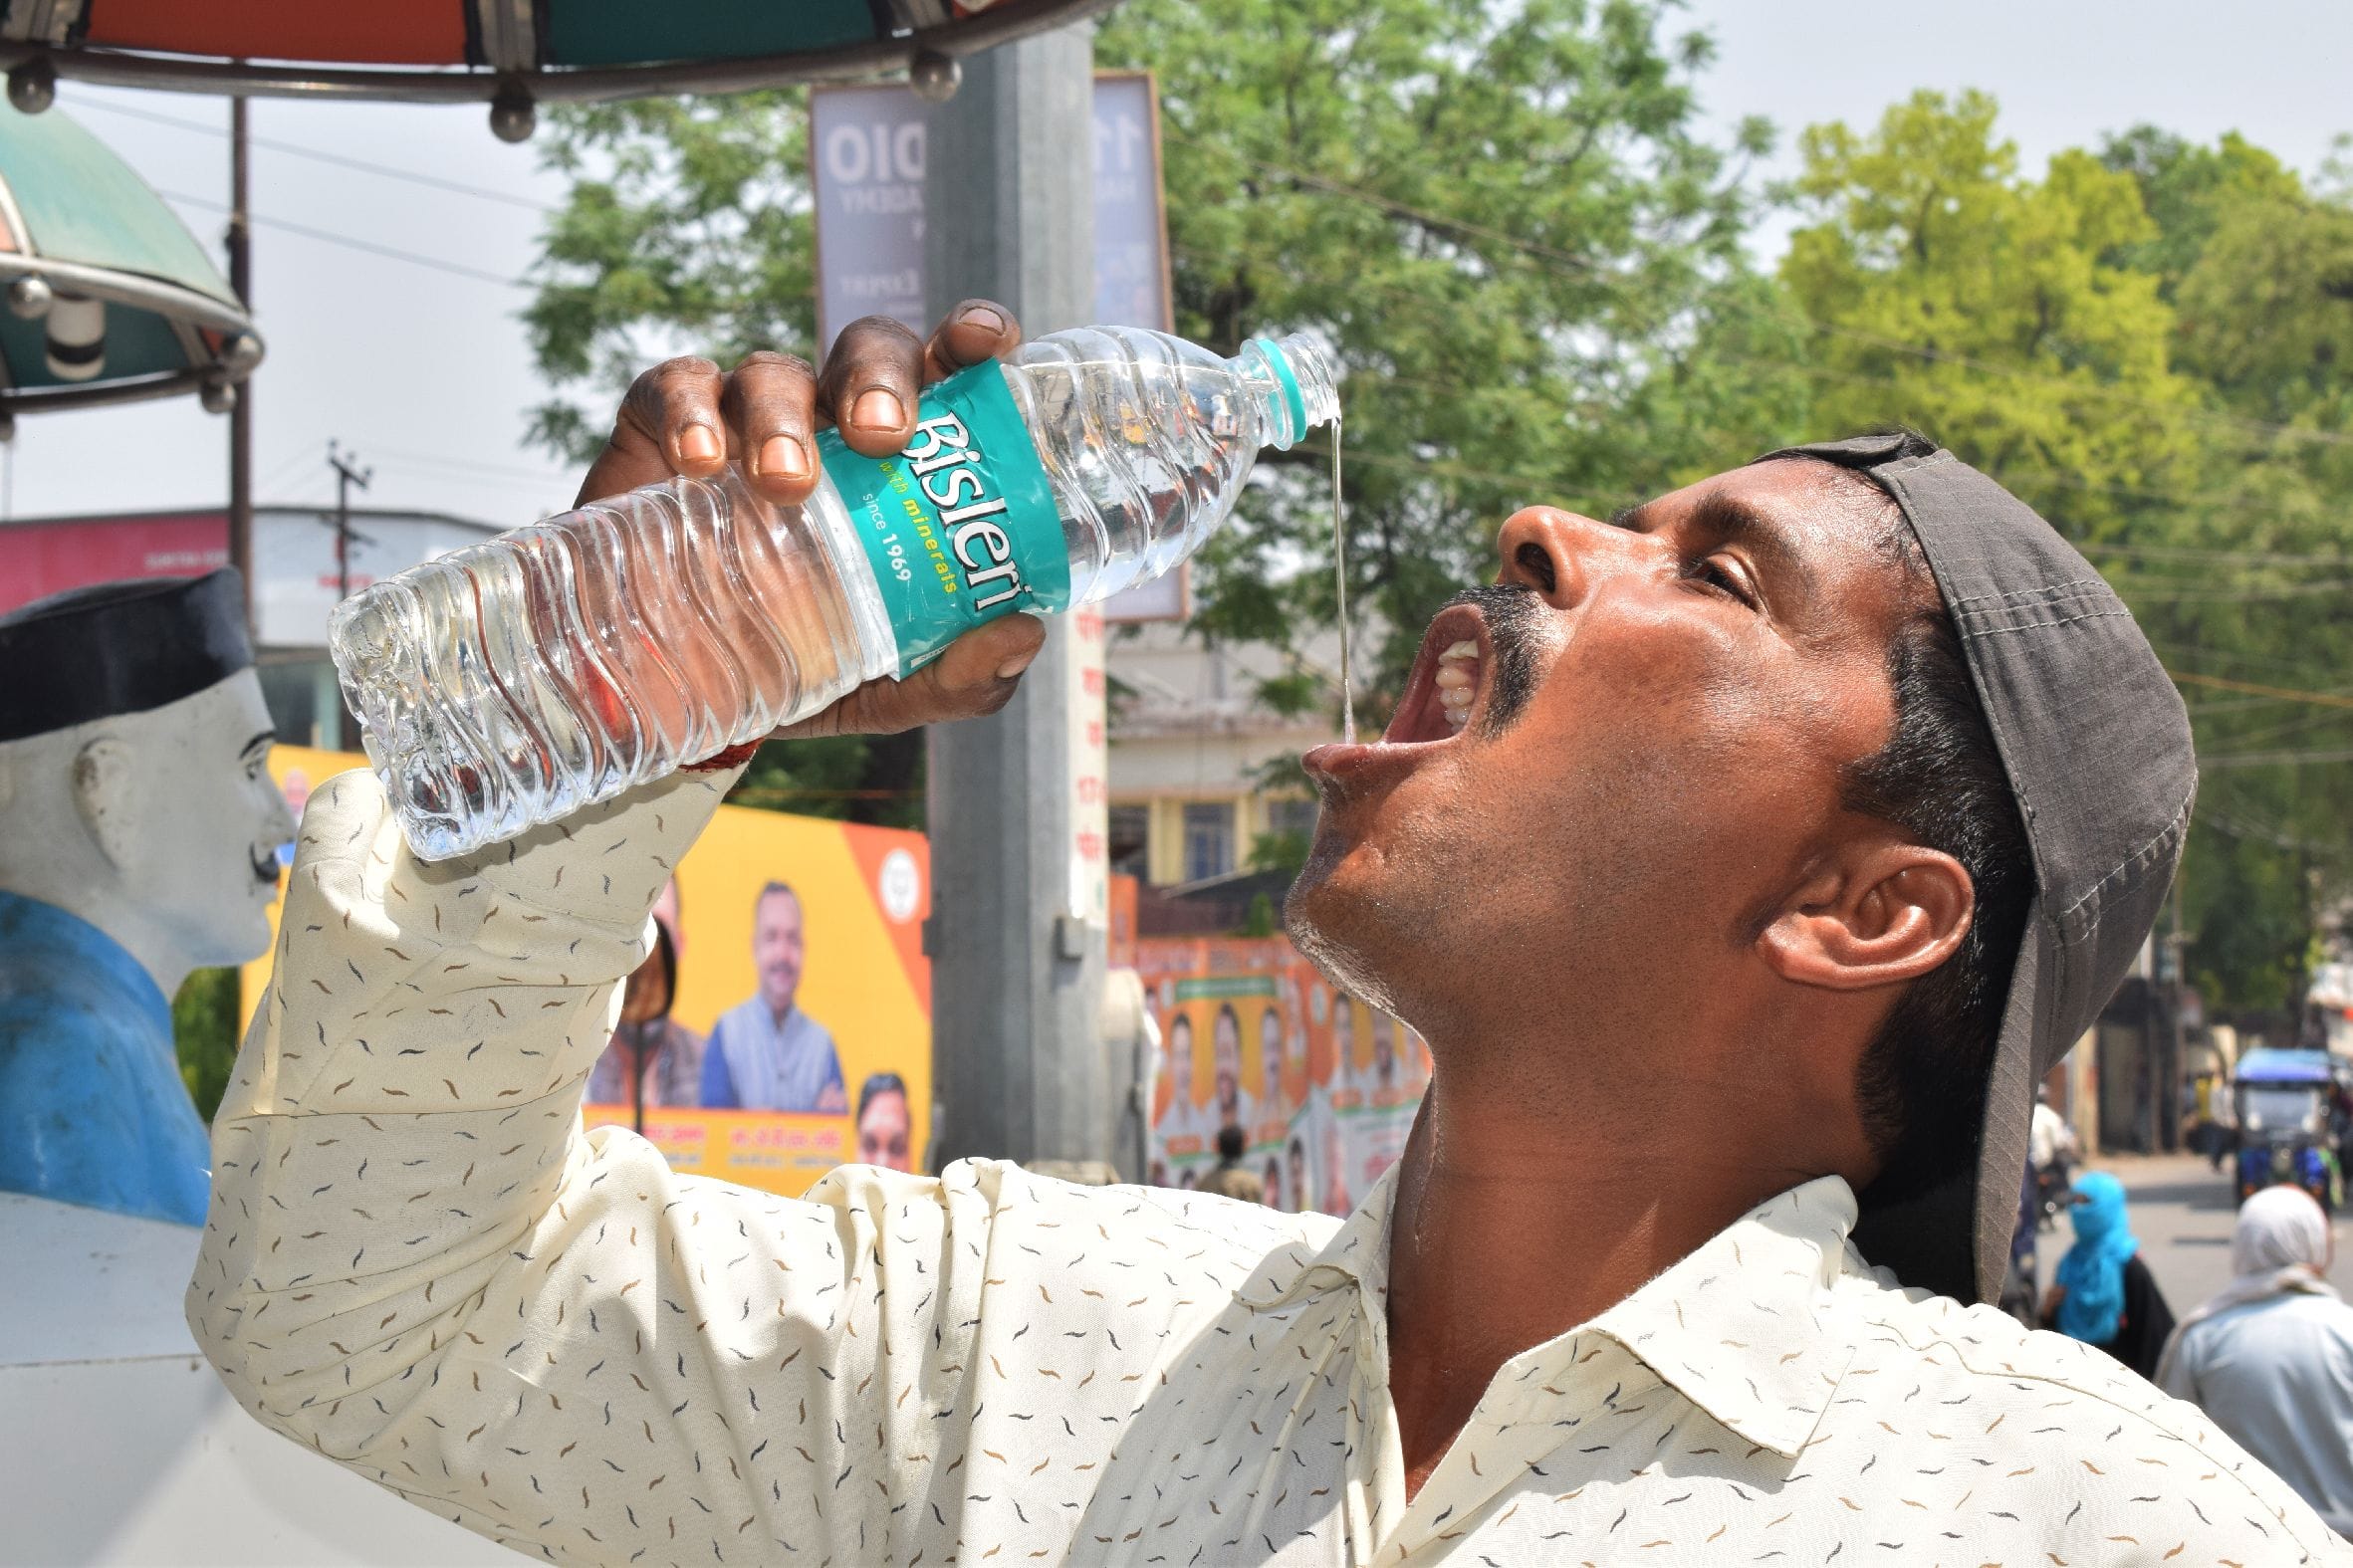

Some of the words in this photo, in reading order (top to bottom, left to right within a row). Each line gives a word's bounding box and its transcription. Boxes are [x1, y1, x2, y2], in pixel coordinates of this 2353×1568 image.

[862, 493, 886, 531] since
[882, 533, 911, 581] 1969
[879, 462, 909, 495] with
[902, 499, 958, 593] minerals
[899, 410, 1032, 611] Bisleri
